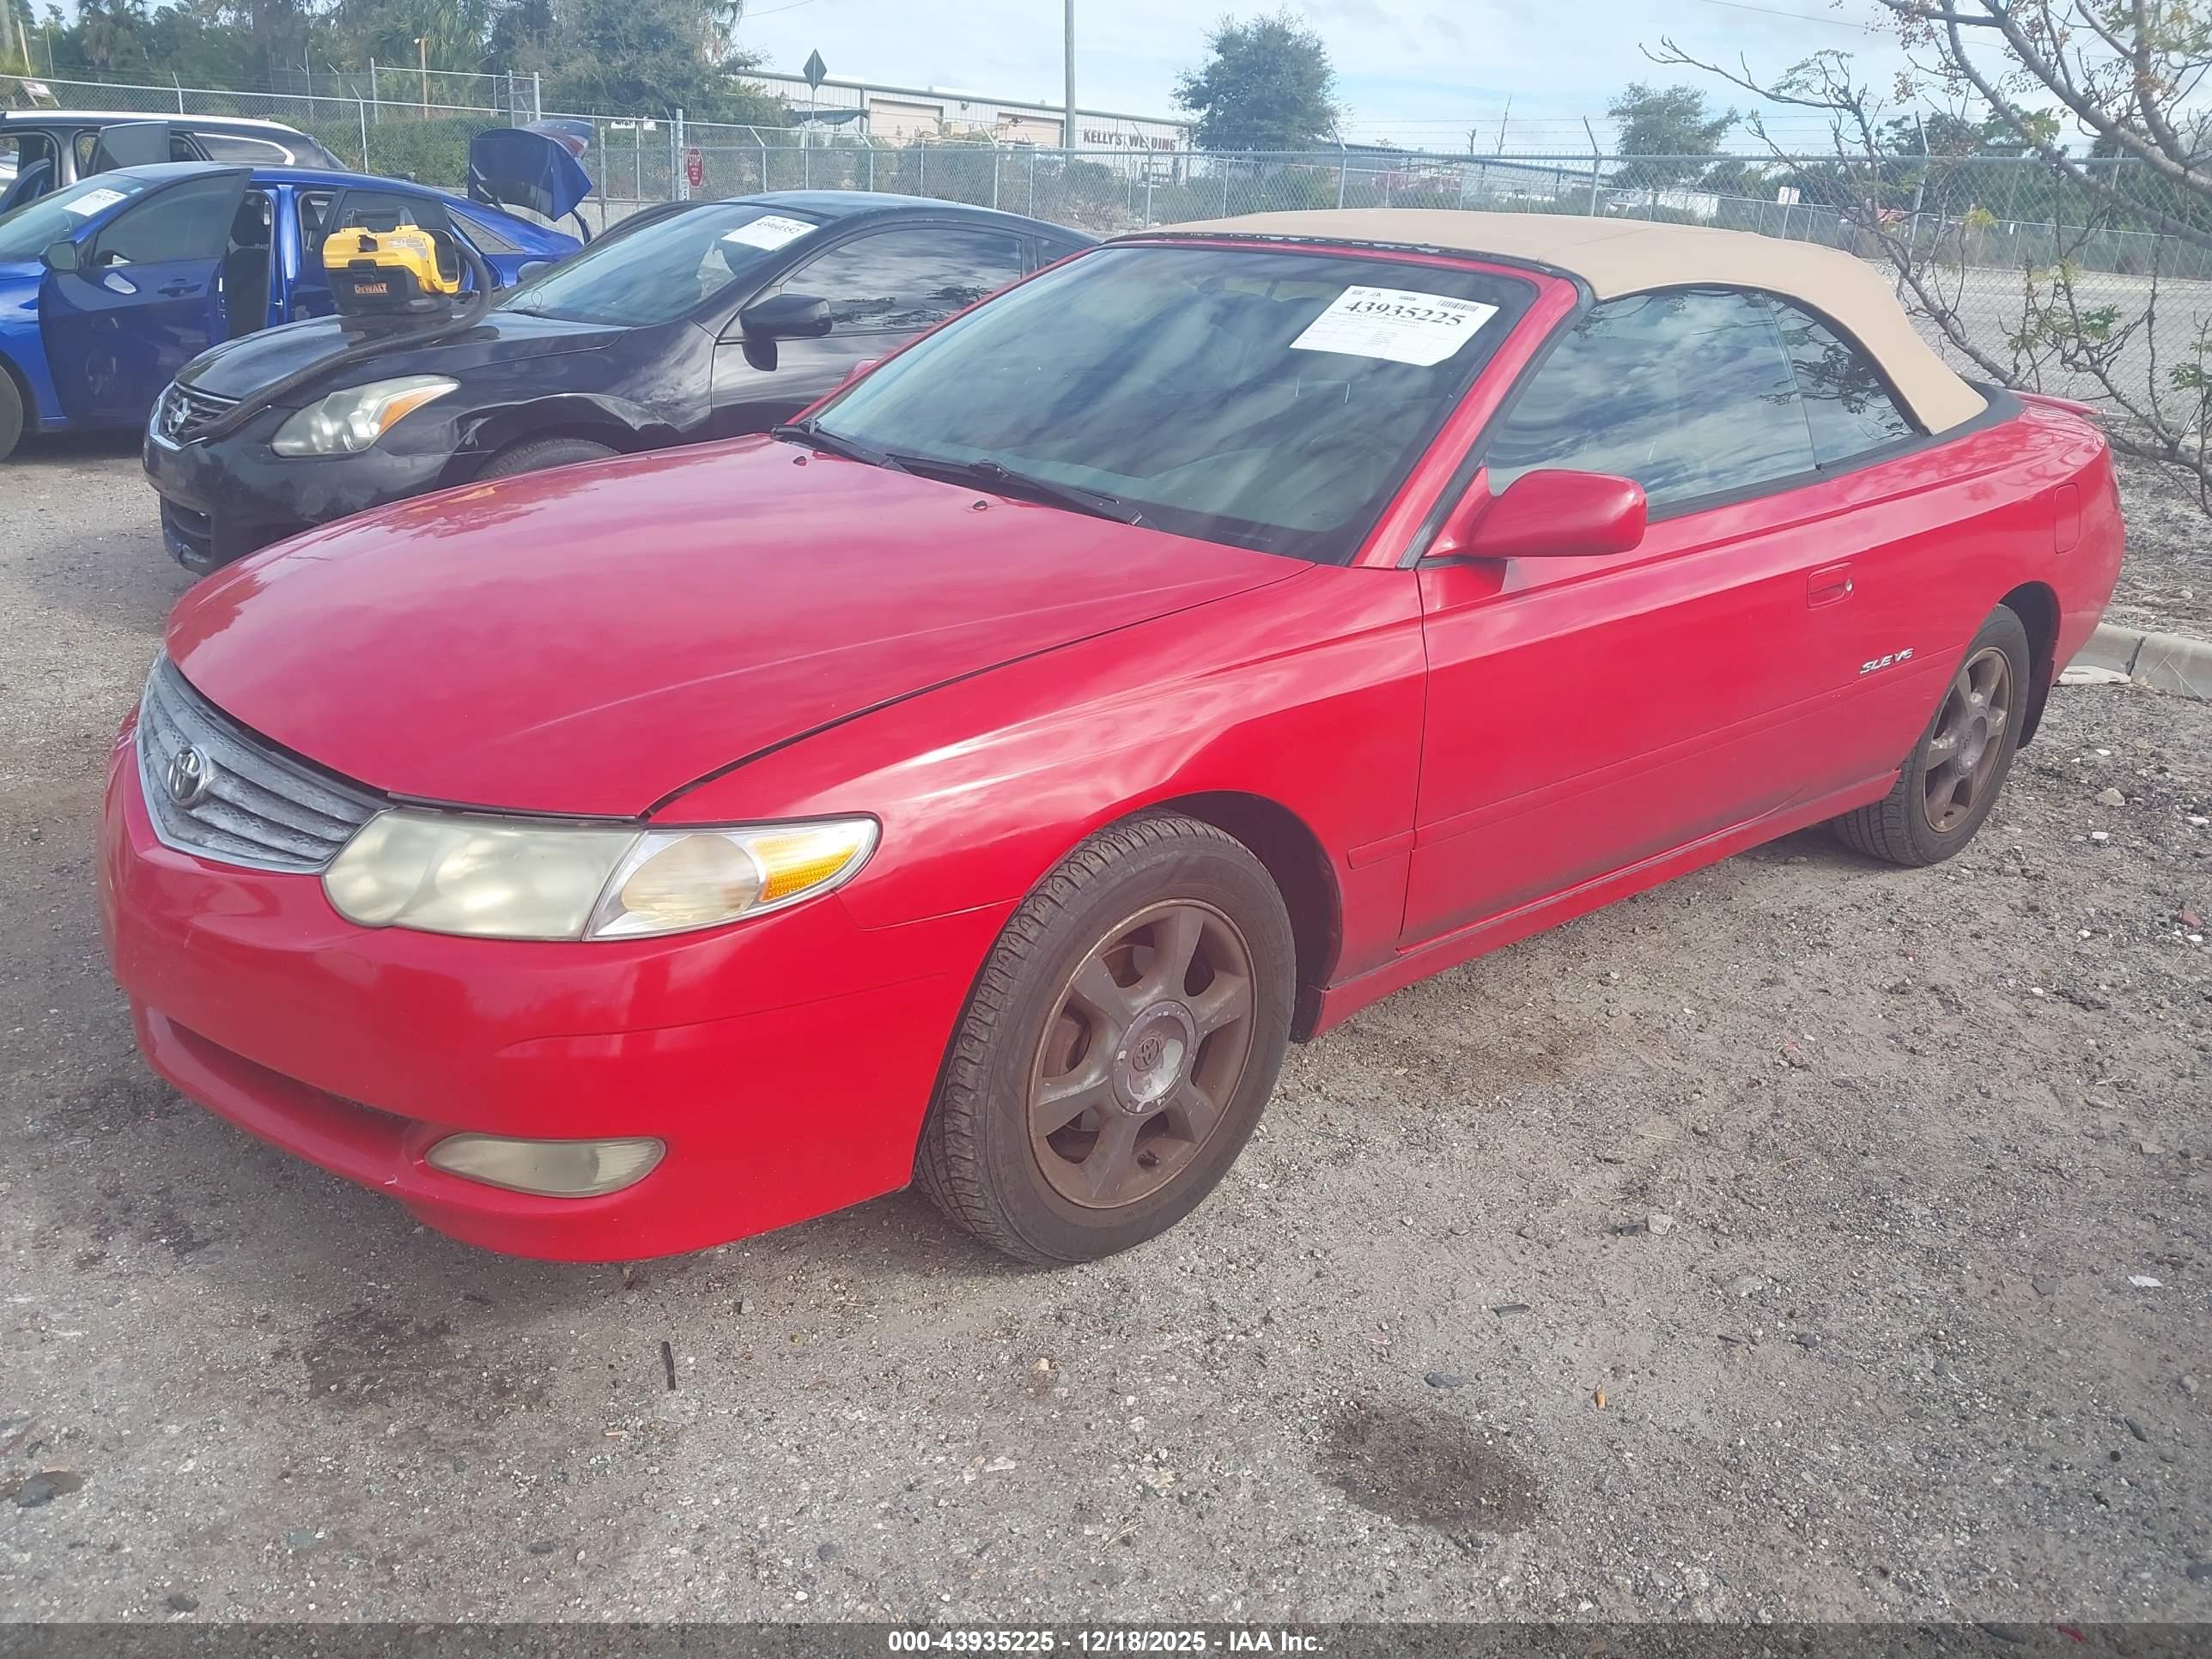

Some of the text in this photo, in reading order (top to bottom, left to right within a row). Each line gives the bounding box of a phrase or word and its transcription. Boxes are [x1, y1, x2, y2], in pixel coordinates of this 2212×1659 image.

[1083, 130, 1122, 146] KELLY'S
[689, 154, 701, 167] STOP
[1345, 301, 1467, 326] 43935225
